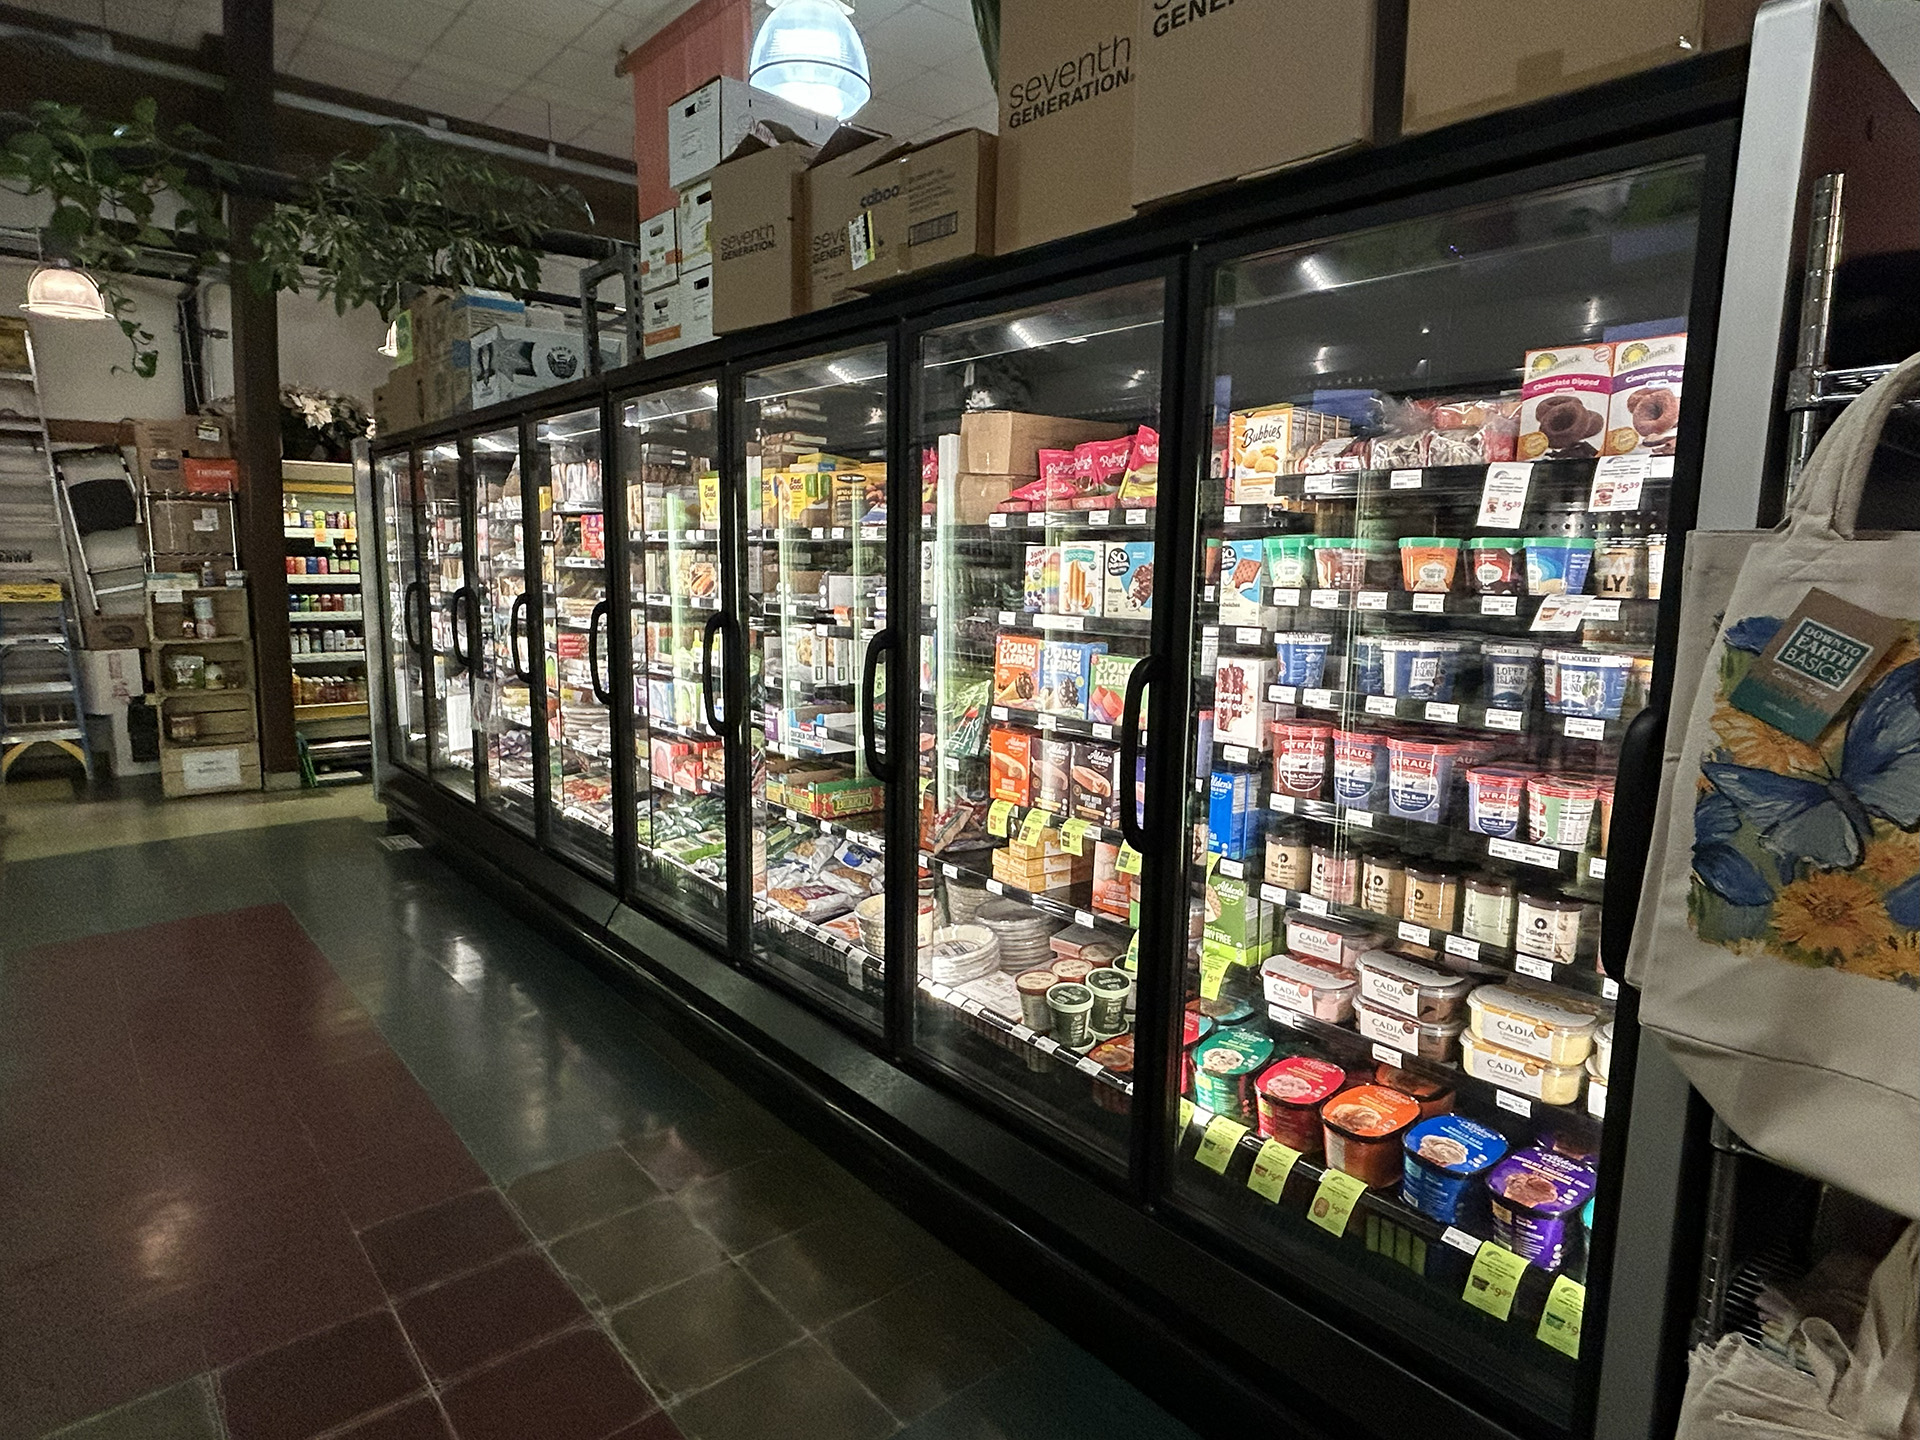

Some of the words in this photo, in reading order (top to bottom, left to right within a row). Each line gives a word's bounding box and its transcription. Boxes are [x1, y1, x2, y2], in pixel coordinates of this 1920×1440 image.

[1010, 35, 1132, 109] seventh
[720, 223, 775, 251] seventh
[720, 240, 776, 262] GENERATION
[1533, 379, 1571, 391] Chocolate
[1571, 378, 1600, 388] Dipped
[1625, 370, 1666, 384] Cinnamon
[1242, 424, 1282, 449] Bubbies
[1804, 626, 1843, 649] DOWN
[1843, 643, 1862, 657] TO
[1795, 635, 1856, 669] EARTH
[1496, 666, 1525, 676] LOPEZ
[1784, 647, 1845, 683] BASICS
[1283, 741, 1325, 751] STRAUS
[1334, 747, 1373, 760] STRAUS
[1391, 758, 1436, 771] STRAUS
[1479, 791, 1520, 802] STRAUS
[1299, 932, 1329, 946] CADIA
[1525, 927, 1558, 940] talent
[1273, 984, 1301, 998] CADIA
[1372, 979, 1404, 998] CADIA
[1371, 1018, 1405, 1037] CADIA
[1497, 1020, 1537, 1041] CADIA
[1486, 1059, 1528, 1079] CADIA
